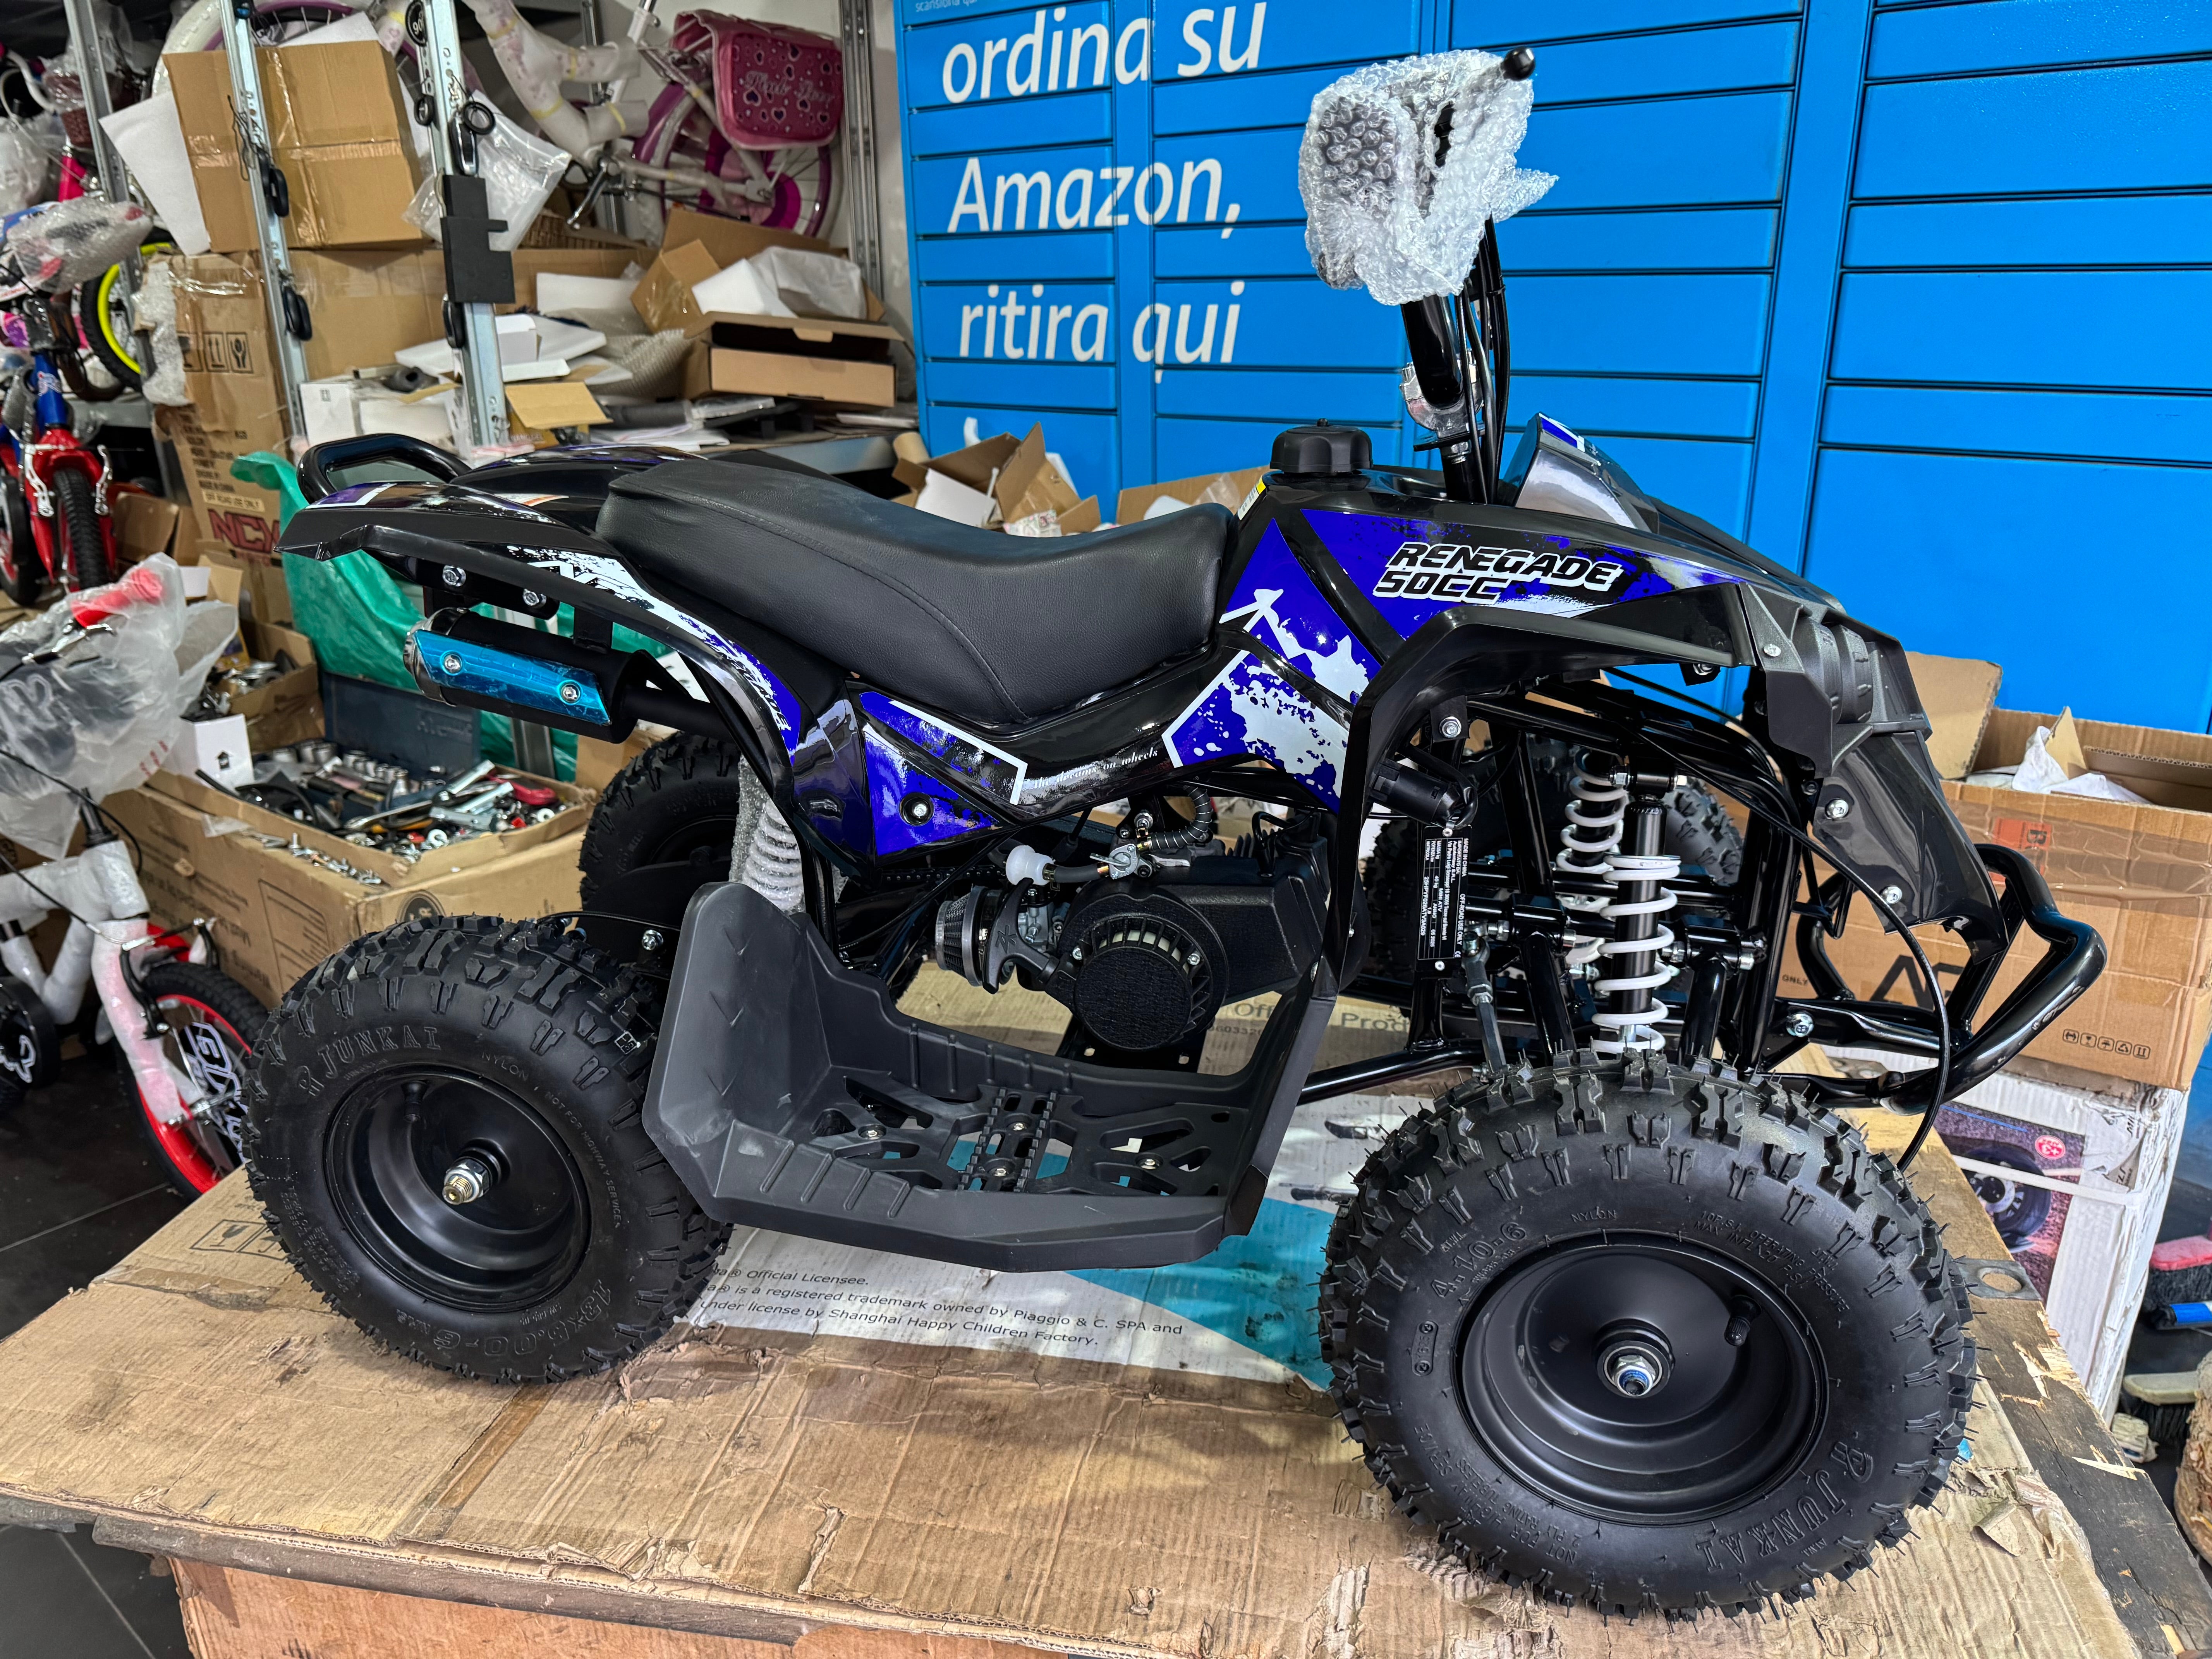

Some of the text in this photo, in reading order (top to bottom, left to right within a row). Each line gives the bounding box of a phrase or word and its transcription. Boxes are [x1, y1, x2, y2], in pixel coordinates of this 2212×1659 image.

[942, 2, 1267, 104] ordina su
[947, 157, 1240, 239] Amazon,
[959, 281, 1245, 384] ritira qui
[1373, 568, 1513, 605] 50CC
[1385, 542, 1624, 591] RENEGADE
[1103, 762, 1116, 770] on
[1122, 747, 1158, 765] wheels
[318, 1025, 441, 1079] JUNKAI
[481, 1051, 529, 1081] NYLON
[544, 1091, 621, 1221] NOT FOR HIGHWAY SERVICE
[1570, 1208, 1618, 1224] NYLON
[1693, 1220, 1721, 1236] MAX
[747, 1270, 797, 1281] Official
[802, 1273, 869, 1285] Licensee.
[735, 1285, 746, 1294] is
[765, 1287, 843, 1301] registered
[848, 1293, 928, 1310] trademark
[933, 1302, 983, 1314] owned
[990, 1305, 1008, 1317] by
[1014, 1309, 1070, 1326] Piaggio
[1077, 1317, 1087, 1327] &
[1094, 1319, 1108, 1328] C.
[1115, 1320, 1146, 1331] SPA
[1152, 1322, 1183, 1334] and
[748, 1302, 800, 1316] license
[805, 1307, 824, 1319] by
[829, 1309, 903, 1326] Shanghai
[907, 1317, 957, 1331] Happy
[963, 1321, 1028, 1338] Children
[1035, 1331, 1099, 1346] Factory.
[1411, 1422, 1456, 1477] SERVICE
[1446, 1479, 1508, 1528] HIGHWAY
[1451, 1456, 1503, 1504] TUBELESS
[1498, 1500, 1542, 1531] RATING
[1505, 1524, 1540, 1549] FOR
[1696, 1470, 1847, 1571] JUNKAI
[1544, 1542, 1577, 1564] NOT
